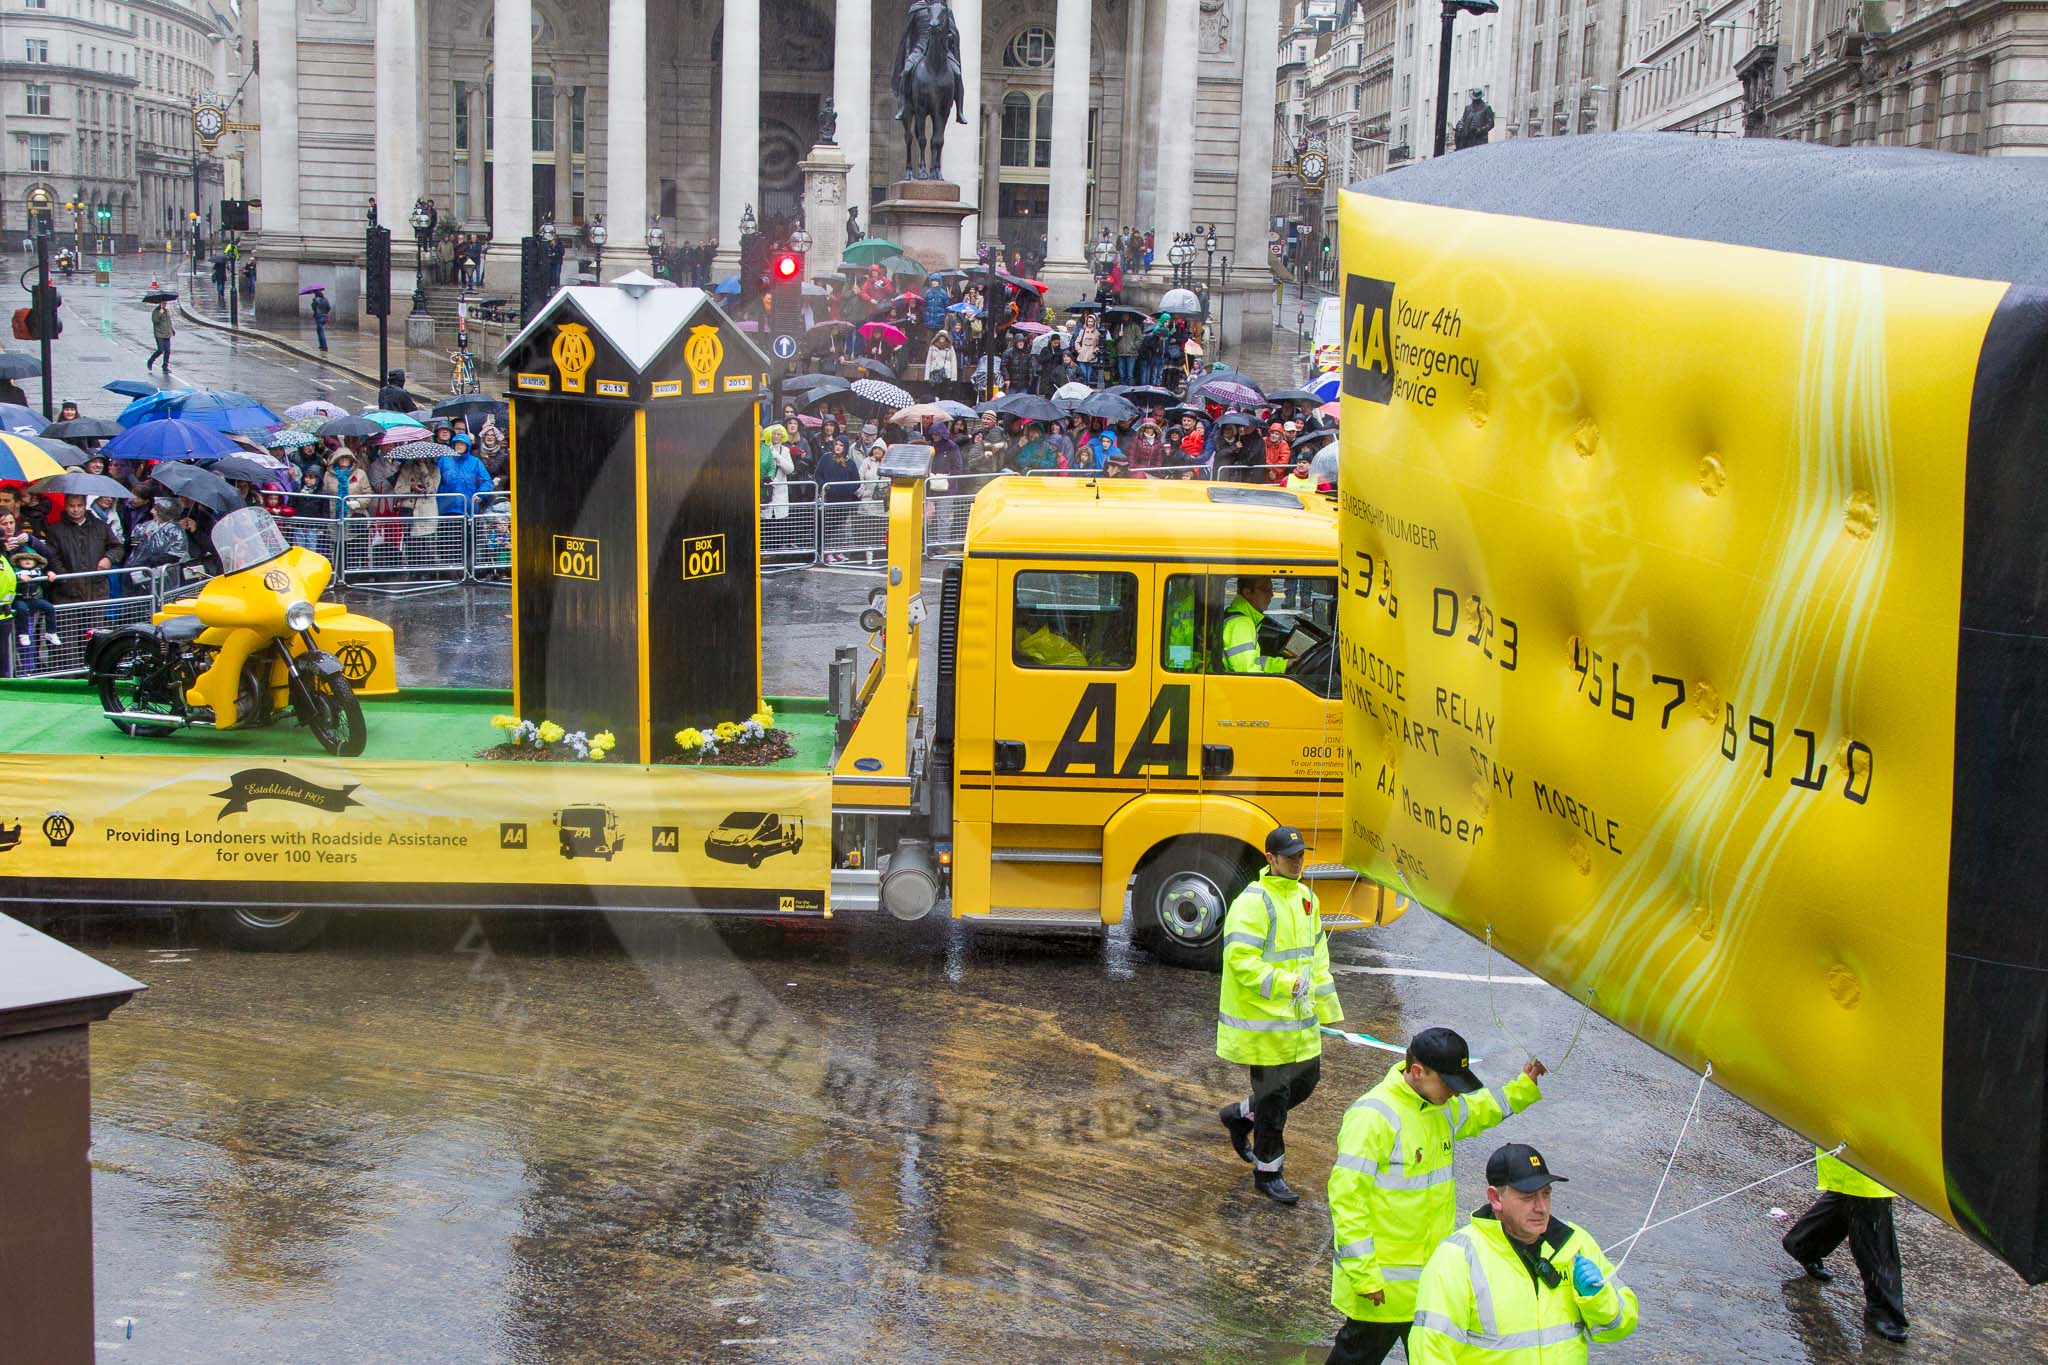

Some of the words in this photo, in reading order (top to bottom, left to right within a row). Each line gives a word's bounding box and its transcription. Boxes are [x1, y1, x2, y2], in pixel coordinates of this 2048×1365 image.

[1396, 298, 1430, 331] Your
[1431, 307, 1462, 338] 4th
[1345, 303, 1389, 375] AA
[1394, 334, 1480, 386] Emergency
[728, 379, 746, 387] 2013
[1342, 490, 1386, 530] EMBERSHIP
[1386, 514, 1440, 551] NUMBER
[566, 540, 585, 552] BOX
[695, 540, 712, 551] BOX
[559, 551, 594, 577] 001
[688, 550, 721, 576] 001
[1340, 630, 1406, 702] ROADSIDE
[1436, 687, 1495, 745] RELAY
[1045, 682, 1191, 776] AA
[1573, 637, 1686, 730] 4567
[1721, 702, 1873, 805] 8910
[1302, 746, 1332, 758] 0800
[1344, 672, 1378, 719] HOME
[1382, 702, 1440, 757] START
[1470, 746, 1514, 799] STAY
[1533, 780, 1623, 855] MOBILE
[244, 782, 303, 799] Established
[304, 790, 325, 805] 1905
[1346, 745, 1362, 779] Mr
[1376, 764, 1396, 801] AA
[1401, 784, 1484, 846] Member
[106, 828, 180, 846] Providing
[185, 830, 266, 845] Londoners
[271, 832, 306, 846] with
[312, 832, 383, 846] Roadside
[388, 833, 468, 847] Assistance
[503, 828, 524, 843] AA
[655, 831, 676, 847] AA
[216, 848, 239, 863] for
[244, 851, 279, 863] over
[284, 849, 311, 863] 100
[316, 850, 358, 864] Years
[1391, 842, 1429, 880] 1905
[781, 899, 793, 908] AA
